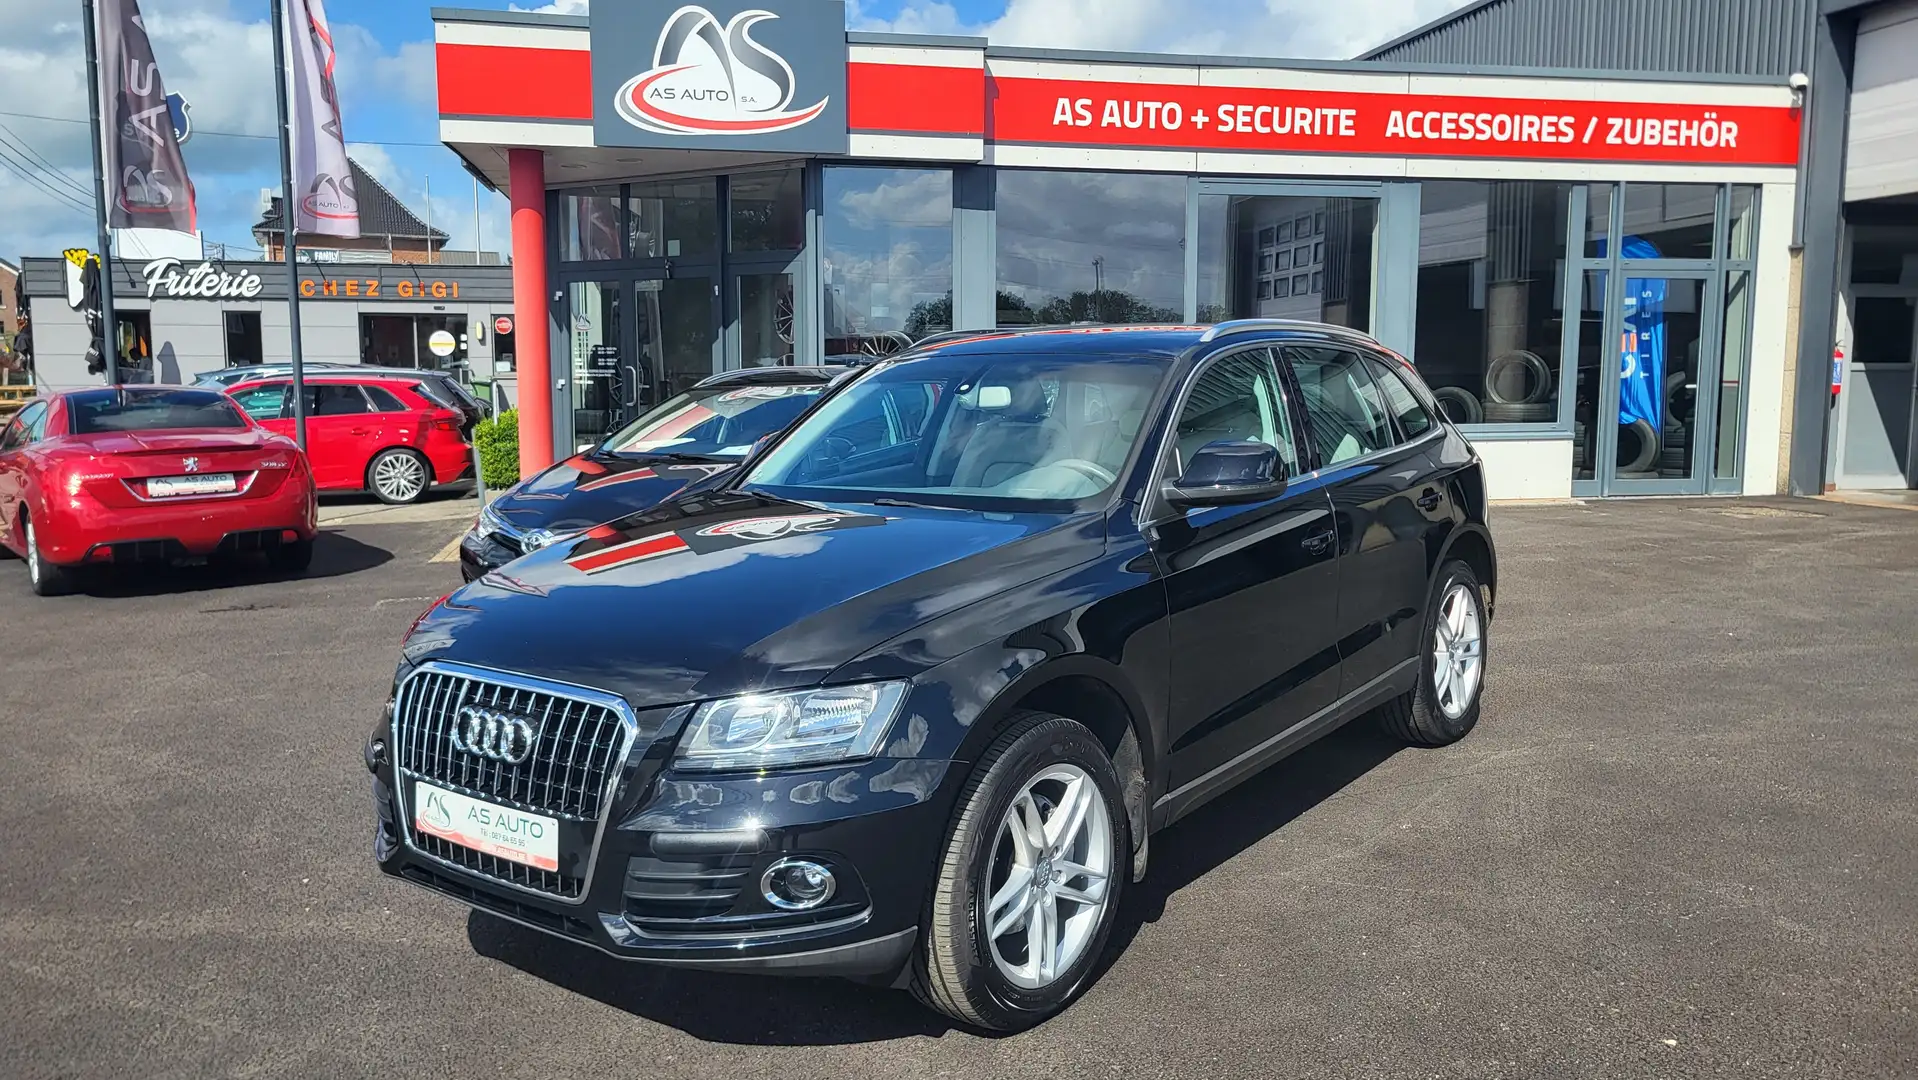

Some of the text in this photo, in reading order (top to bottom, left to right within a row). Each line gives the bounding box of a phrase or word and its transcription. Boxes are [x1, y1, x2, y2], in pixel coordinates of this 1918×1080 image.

[650, 88, 675, 99] AS
[681, 89, 729, 101] AUTO
[1053, 97, 1738, 148] AS AUTO + SECURITE ACCESSOIRES / ZUBEHÖR
[315, 250, 339, 262] FAMILY
[143, 258, 263, 297] Friterie
[300, 280, 459, 298] CHEZ GIGI
[468, 805, 490, 825] AS
[495, 813, 543, 839] AUTO
